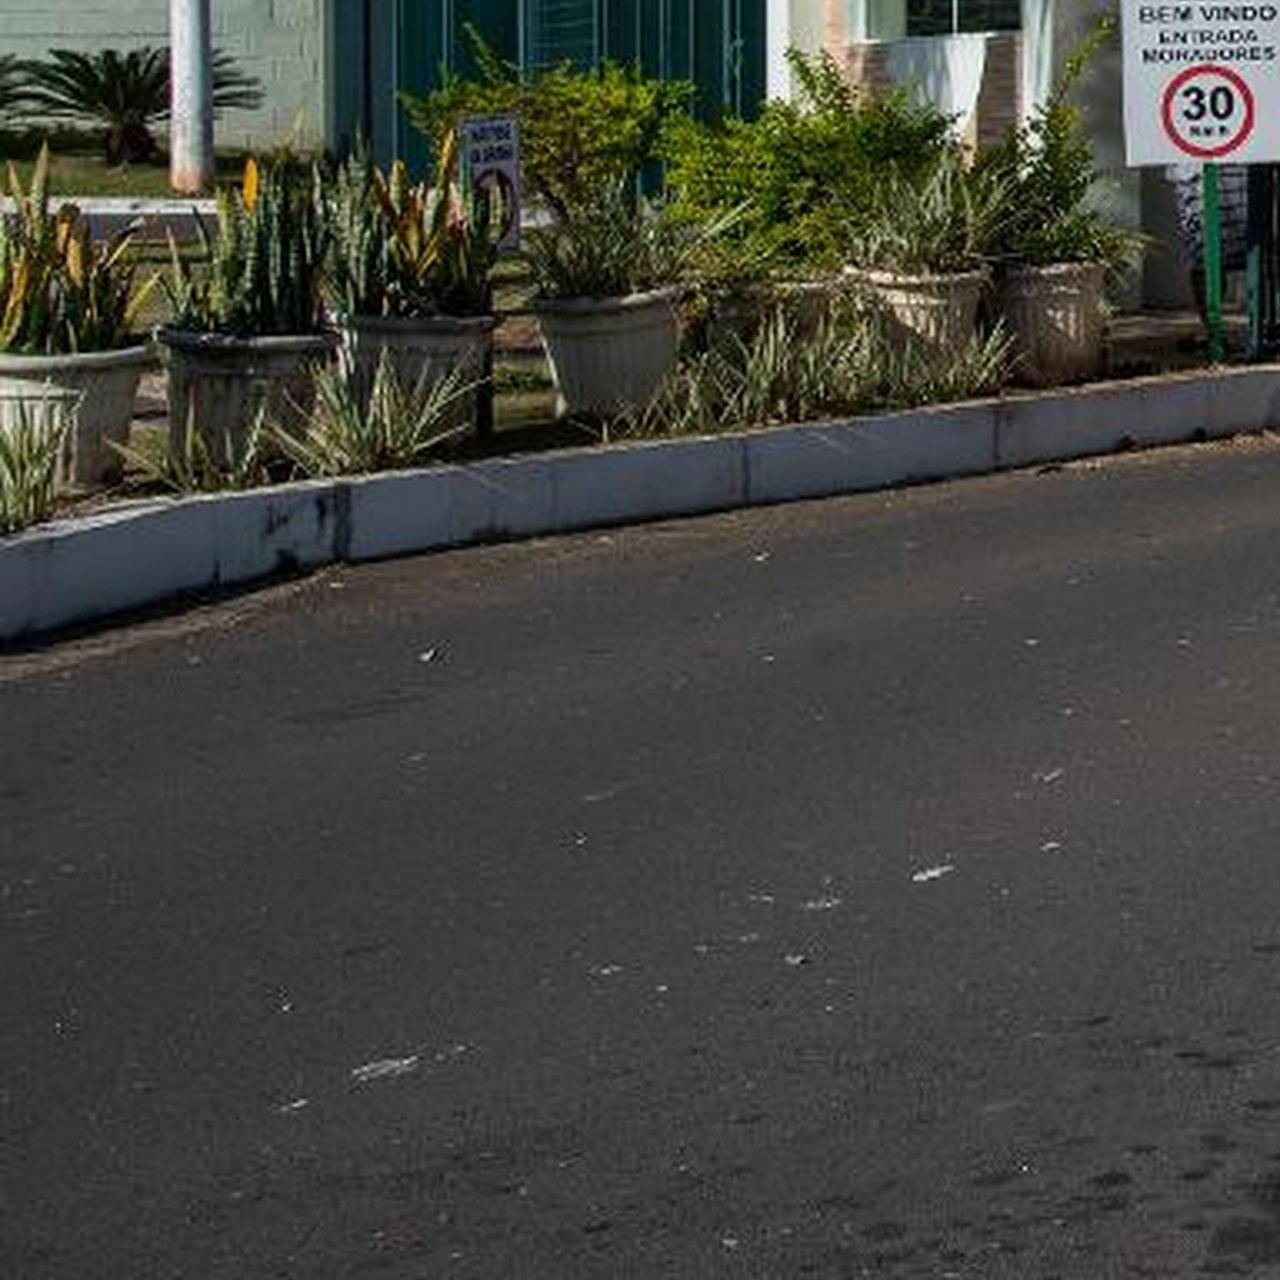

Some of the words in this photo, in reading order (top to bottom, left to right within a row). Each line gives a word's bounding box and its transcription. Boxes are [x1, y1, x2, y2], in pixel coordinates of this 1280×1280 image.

[1139, 6, 1194, 23] BEM
[1200, 5, 1278, 22] VINDO
[1159, 29, 1259, 45] ENTRADA
[1142, 46, 1277, 64] MORADORES
[1182, 86, 1235, 121] 30
